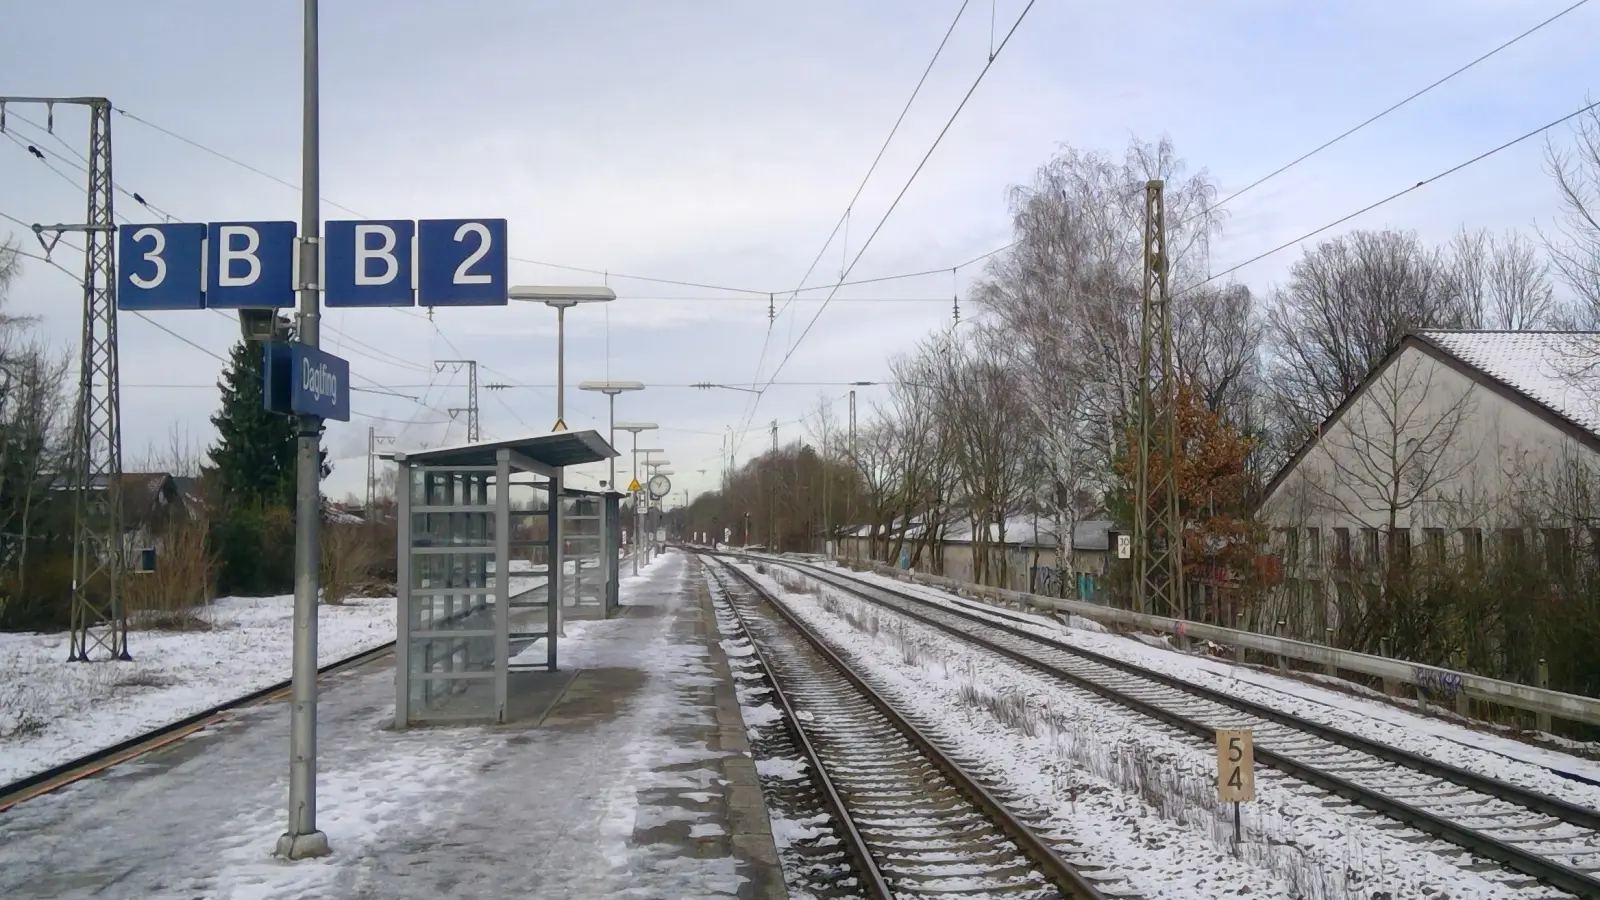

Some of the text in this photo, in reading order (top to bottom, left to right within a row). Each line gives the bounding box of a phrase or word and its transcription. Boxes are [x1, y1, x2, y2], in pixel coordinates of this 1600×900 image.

[129, 226, 262, 289] 3 B
[355, 222, 492, 286] B 2
[302, 356, 337, 406] Daglfing
[1228, 737, 1243, 762] 5
[1227, 765, 1243, 791] 4
